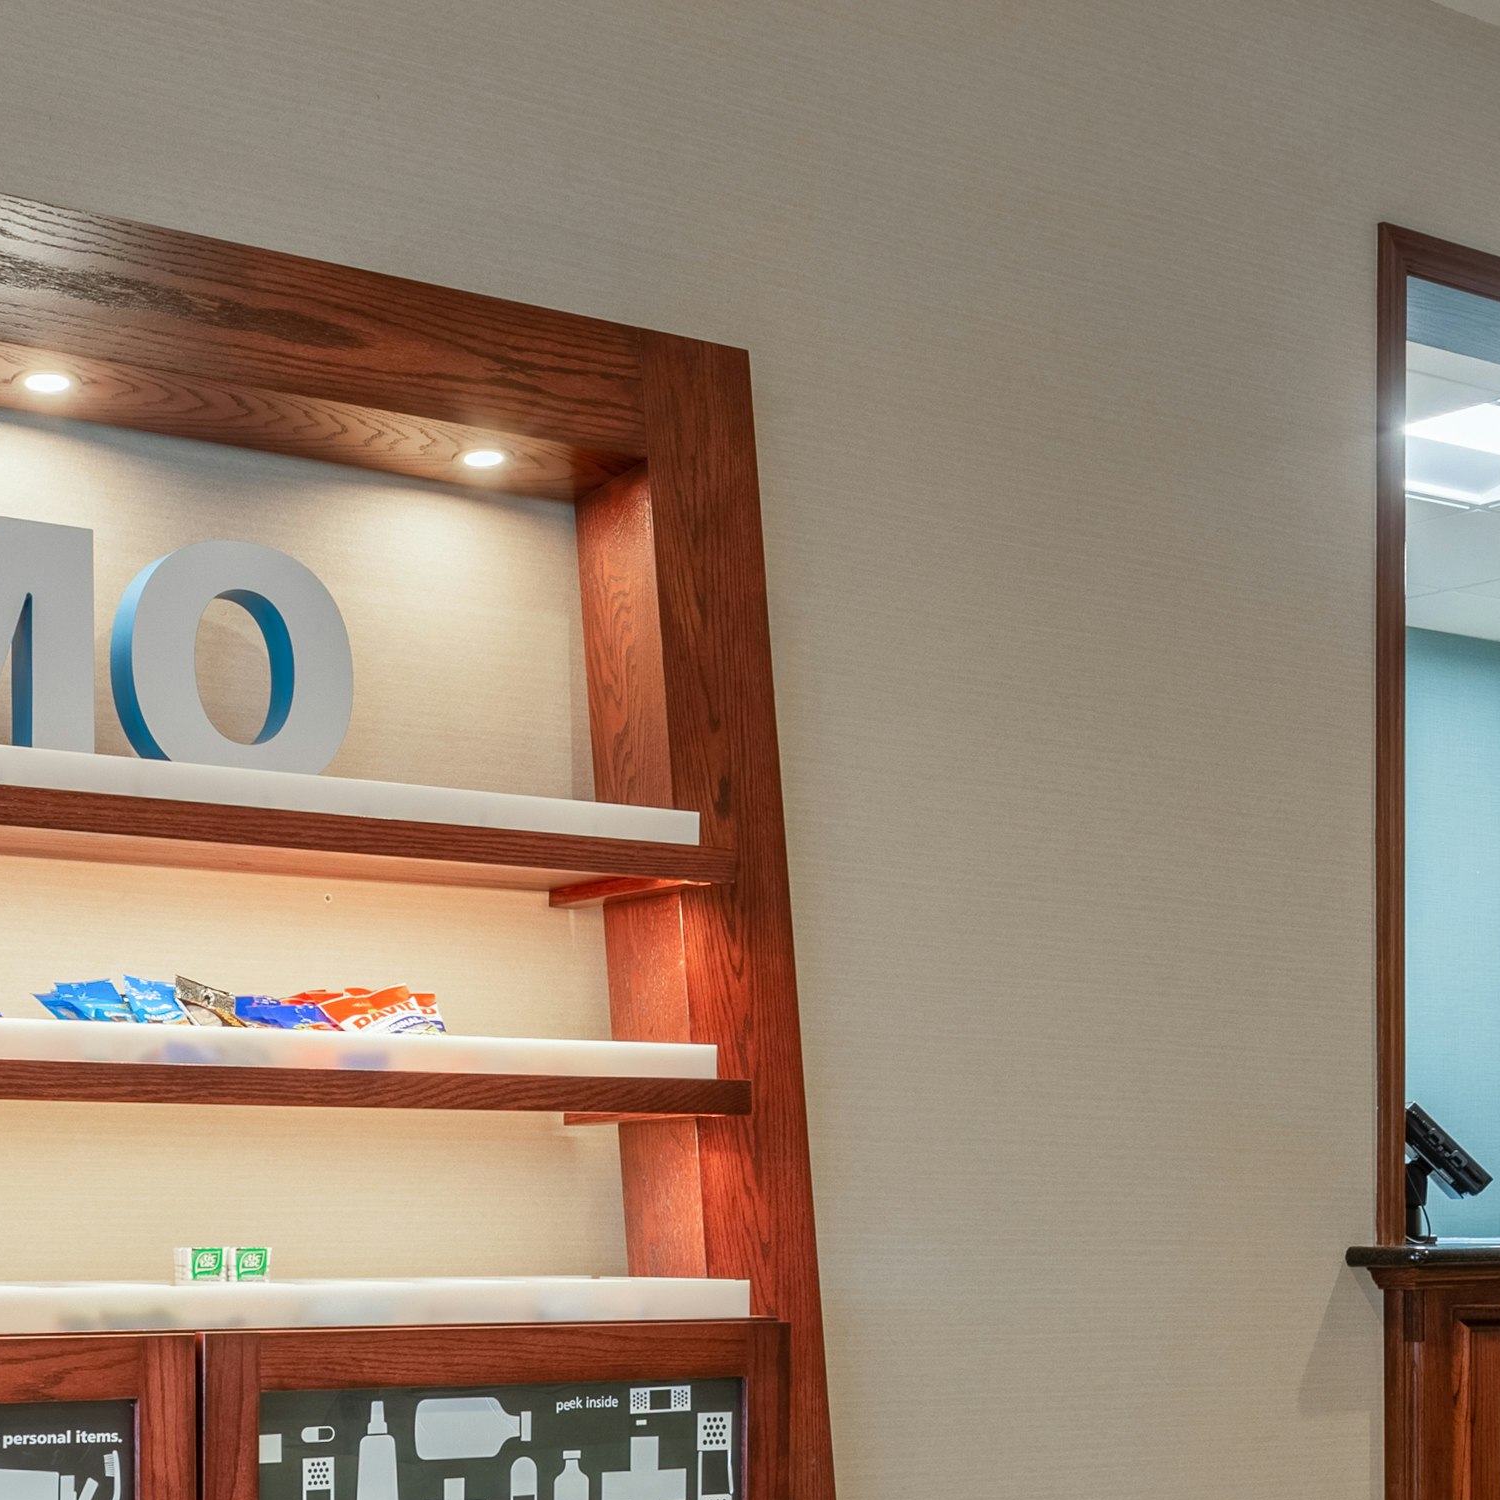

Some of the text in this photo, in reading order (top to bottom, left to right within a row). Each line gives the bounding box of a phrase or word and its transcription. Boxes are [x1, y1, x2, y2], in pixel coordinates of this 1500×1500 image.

[556, 1395, 619, 1413] peek inside
[2, 1430, 72, 1449] personal
[76, 1430, 123, 1445] items.
